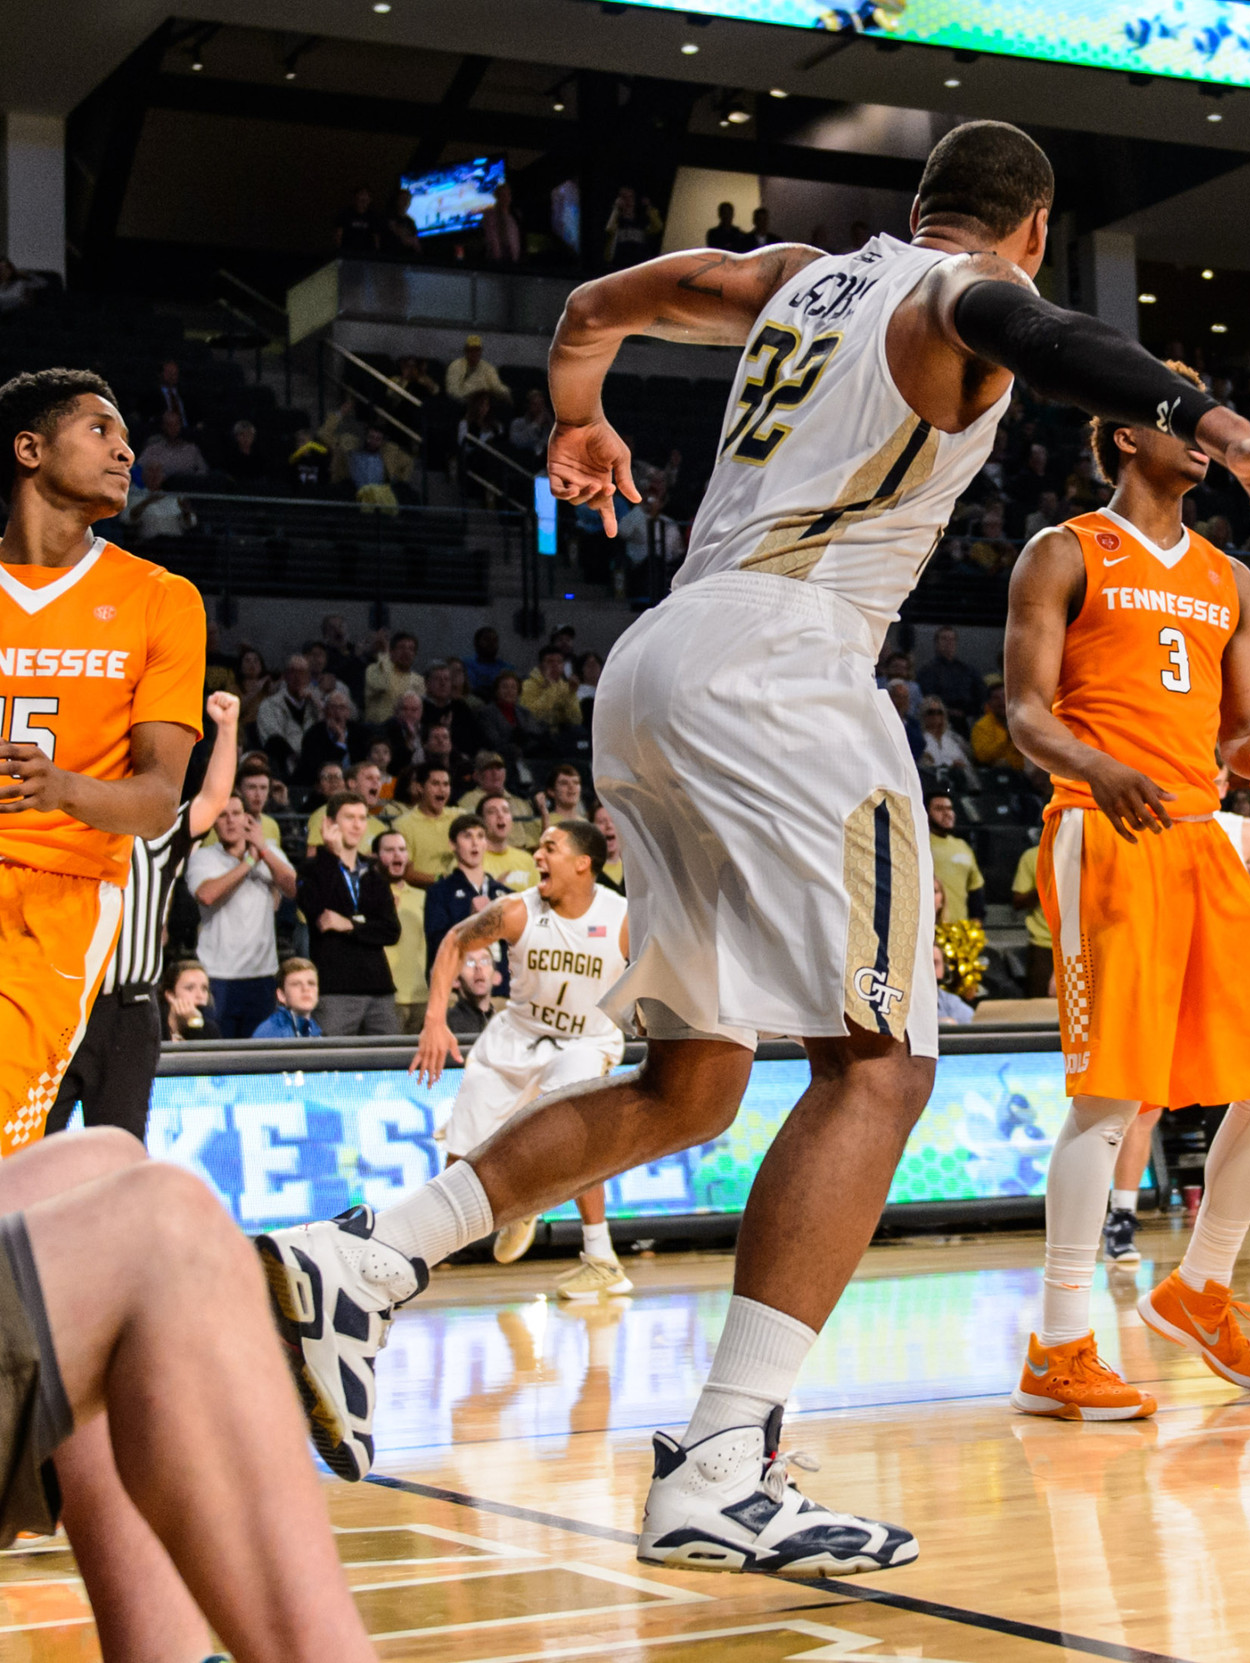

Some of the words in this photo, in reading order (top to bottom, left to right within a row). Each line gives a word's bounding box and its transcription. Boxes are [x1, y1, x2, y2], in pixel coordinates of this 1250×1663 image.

[717, 320, 844, 468] 32
[1101, 586, 1231, 631] TENNESSEE
[1159, 626, 1192, 694] 3
[0, 696, 59, 780] 5
[527, 949, 604, 979] GEORGIA
[556, 981, 569, 1007] 1
[853, 966, 905, 1016] GT
[530, 1001, 587, 1035] TECH
